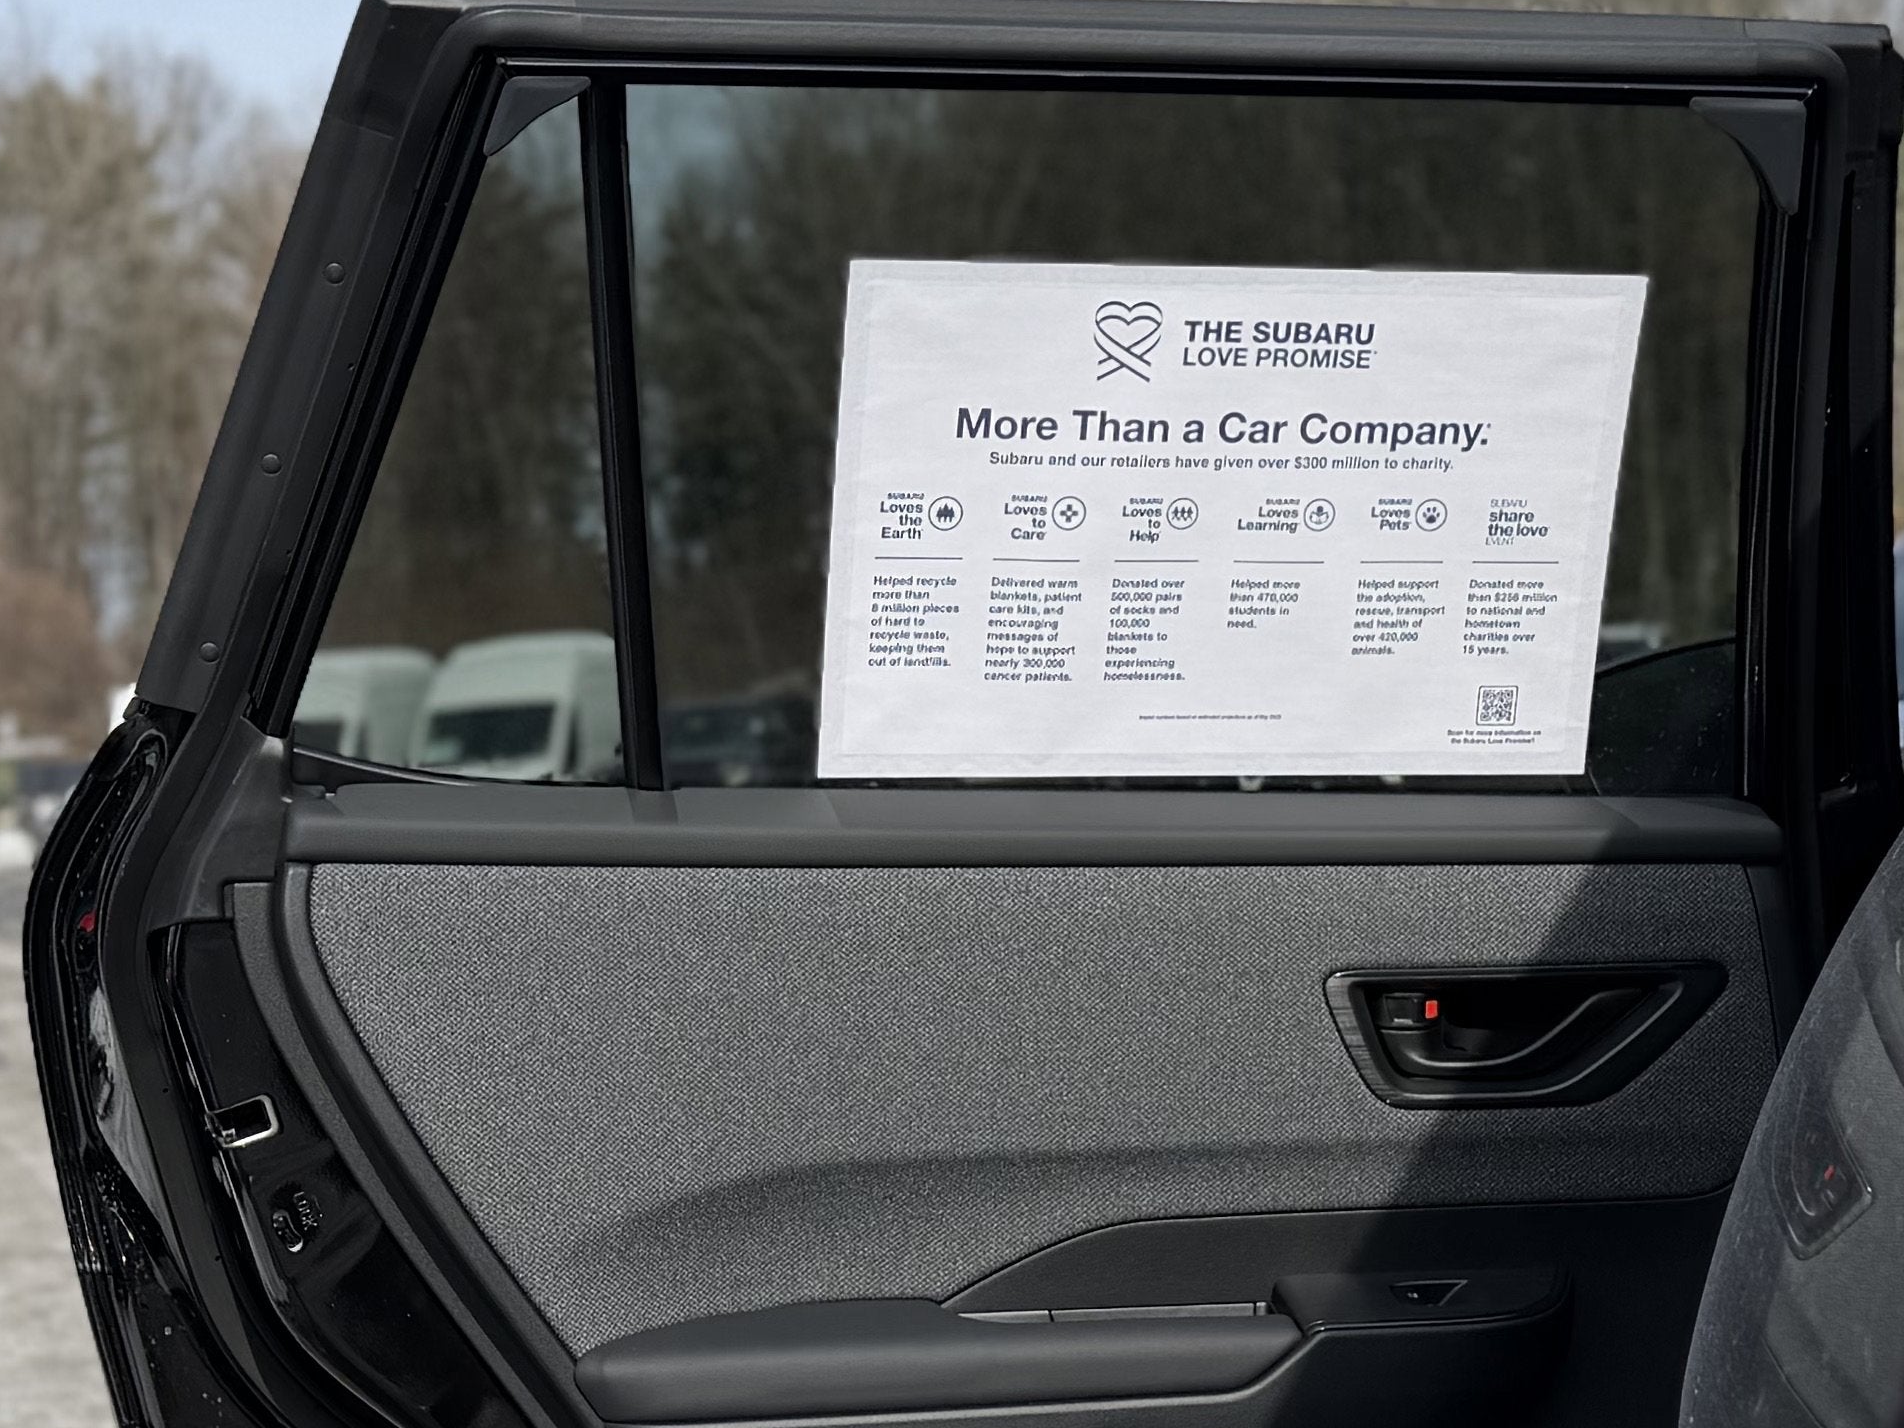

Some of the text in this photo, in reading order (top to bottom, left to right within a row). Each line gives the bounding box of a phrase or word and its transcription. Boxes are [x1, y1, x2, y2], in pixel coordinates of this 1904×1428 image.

[1185, 320, 1376, 344] THE SUBARU
[1182, 347, 1372, 369] LOVE PROMISE
[955, 407, 1489, 451] More Than a Car Company.
[989, 451, 1454, 472] Subaru and our retailers have given over $300 million to charity.
[880, 501, 923, 513] Loves
[1004, 503, 1047, 515] Loves
[1122, 505, 1162, 517] Loves
[1258, 506, 1299, 518] Loves
[1371, 506, 1411, 518] Loves
[898, 514, 923, 526] the
[1489, 509, 1535, 522] share
[1032, 517, 1046, 528] to
[1148, 518, 1161, 528] to
[1237, 518, 1298, 533] Learning
[1379, 519, 1410, 530] Pets
[881, 526, 922, 539] Earth
[1011, 527, 1046, 540] Care
[1129, 530, 1160, 543] Help
[1488, 523, 1549, 537] the love
